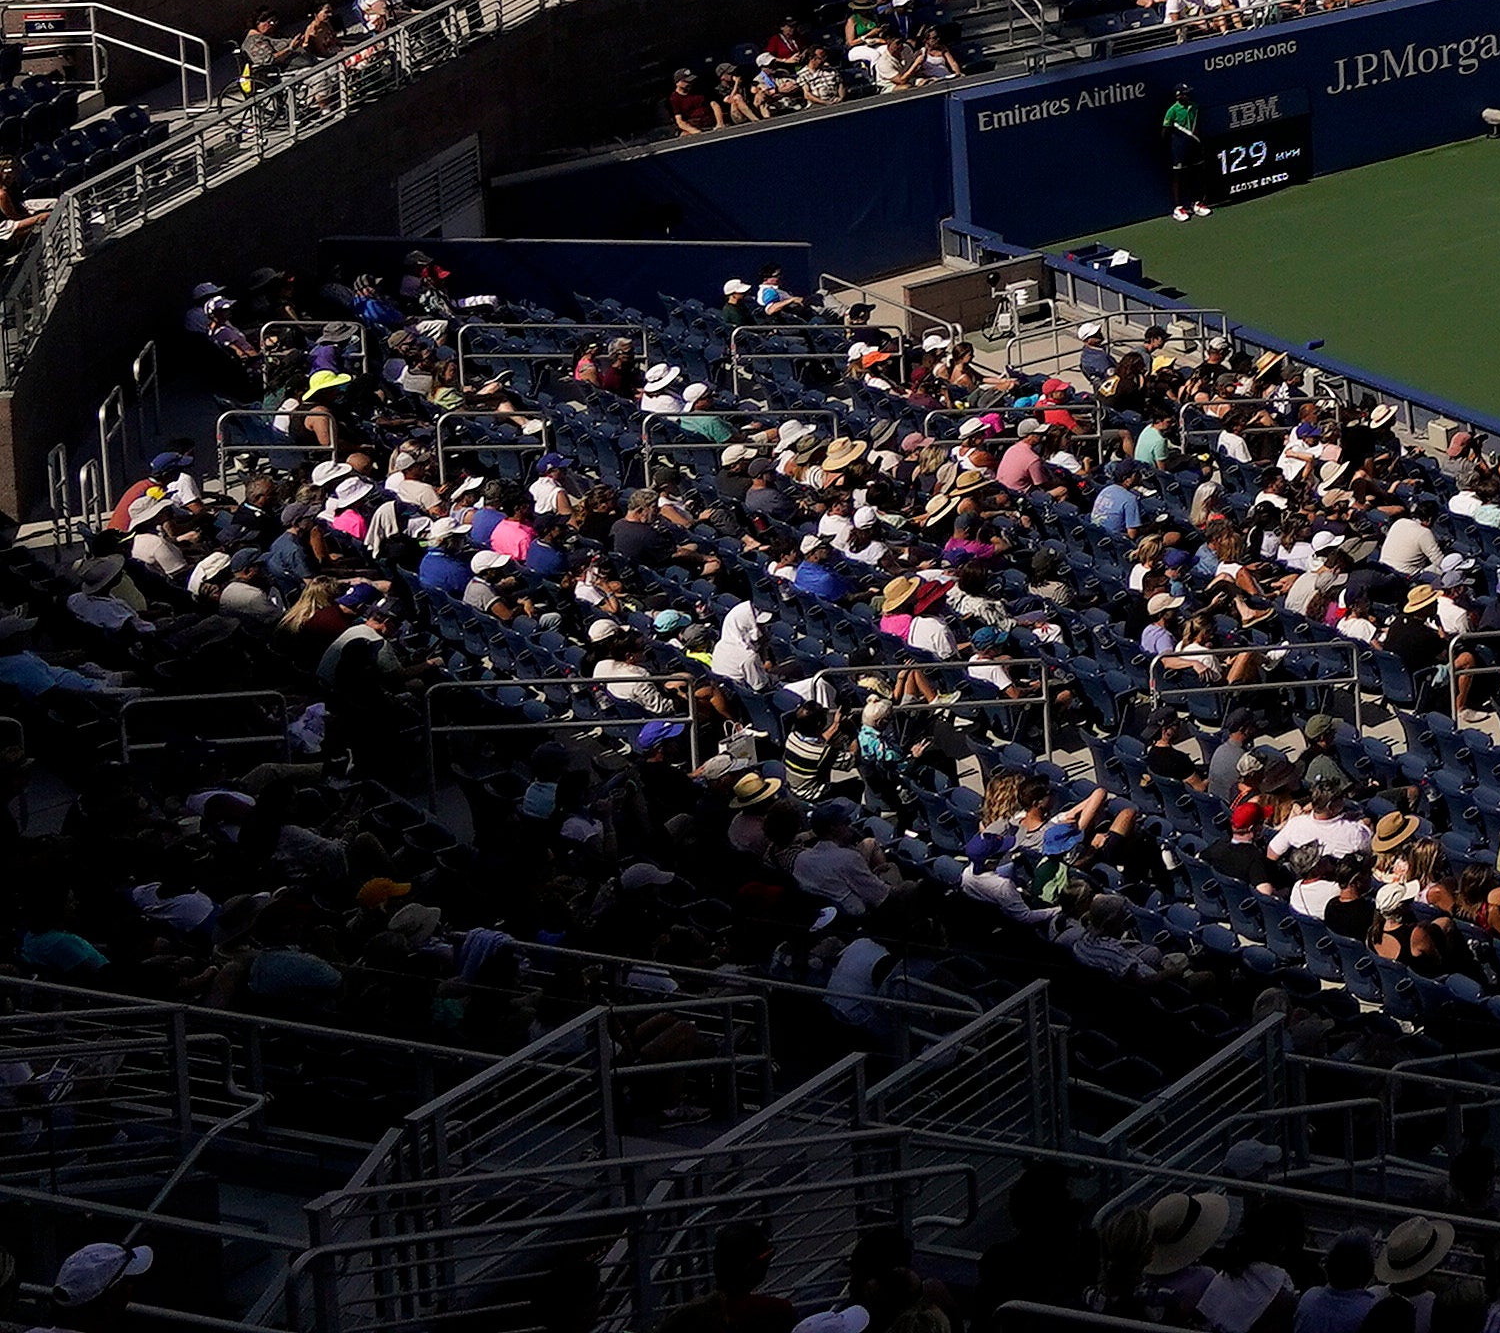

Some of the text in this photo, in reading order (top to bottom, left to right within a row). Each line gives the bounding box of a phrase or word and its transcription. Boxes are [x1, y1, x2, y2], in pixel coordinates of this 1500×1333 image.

[1204, 40, 1297, 71] USOPEN.ORG
[977, 81, 1146, 132] Emirates Airline
[1228, 96, 1282, 129] IBM
[1217, 140, 1268, 175] 129
